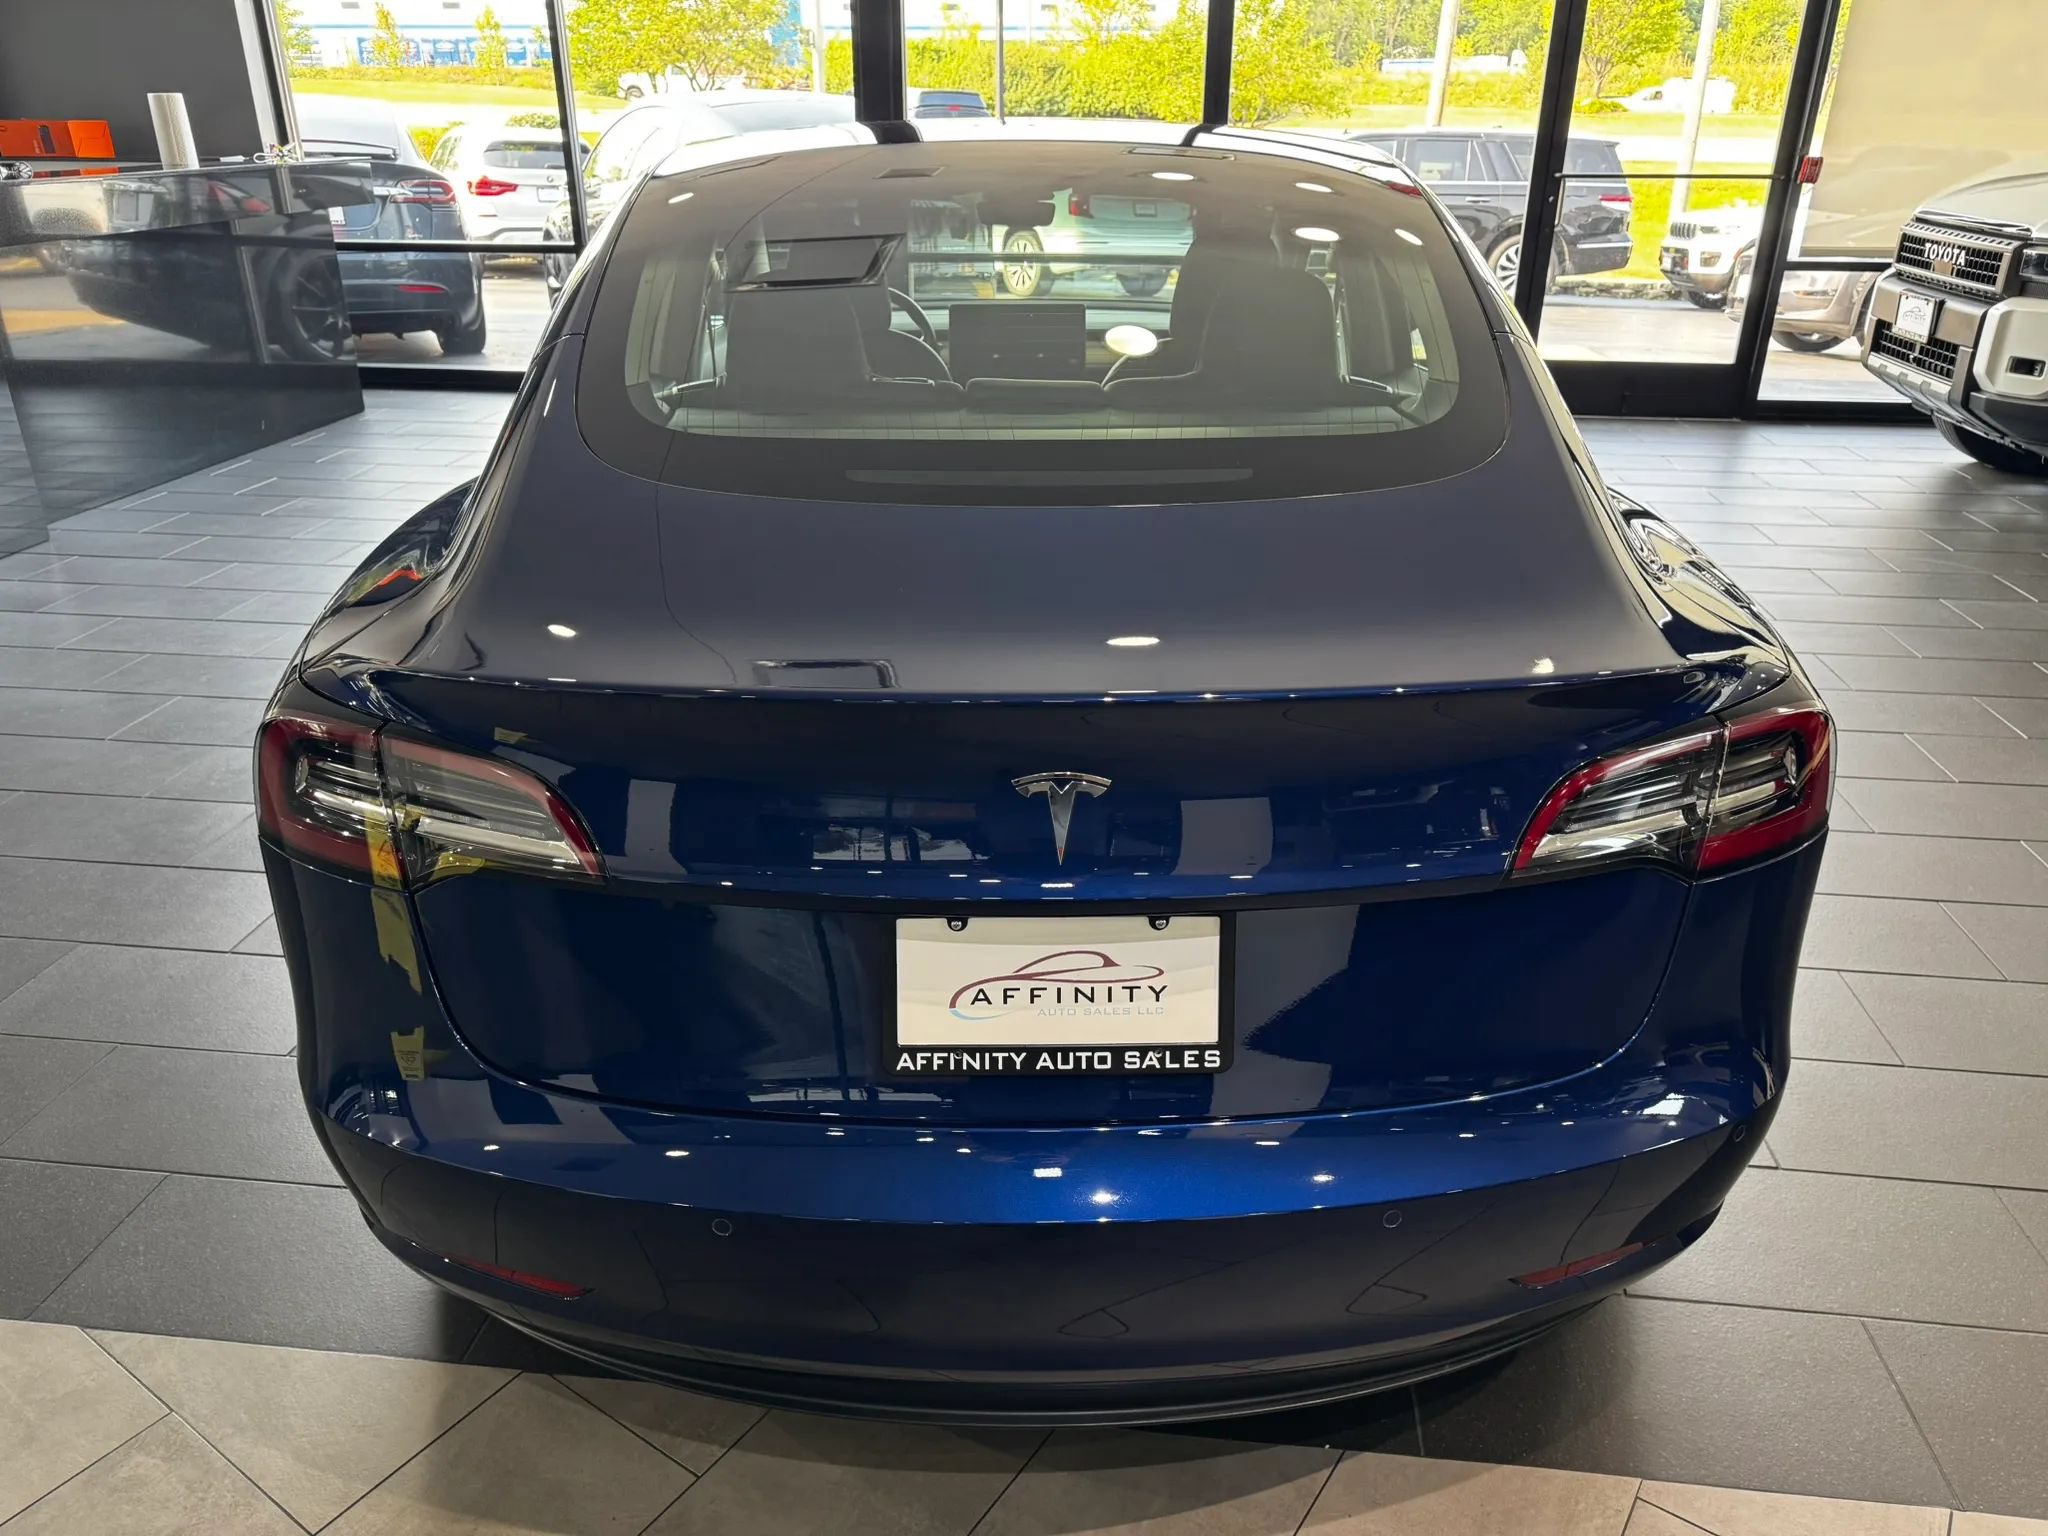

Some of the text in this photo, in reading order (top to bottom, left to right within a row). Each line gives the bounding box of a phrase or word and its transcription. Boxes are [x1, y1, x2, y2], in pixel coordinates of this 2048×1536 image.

[1924, 243, 1966, 266] TOYOTA
[970, 985, 1168, 1006] AFFINITY
[1037, 1007, 1164, 1017] AUTO SALES LLC
[897, 1050, 1221, 1071] AFFINITY AUTO SALES
